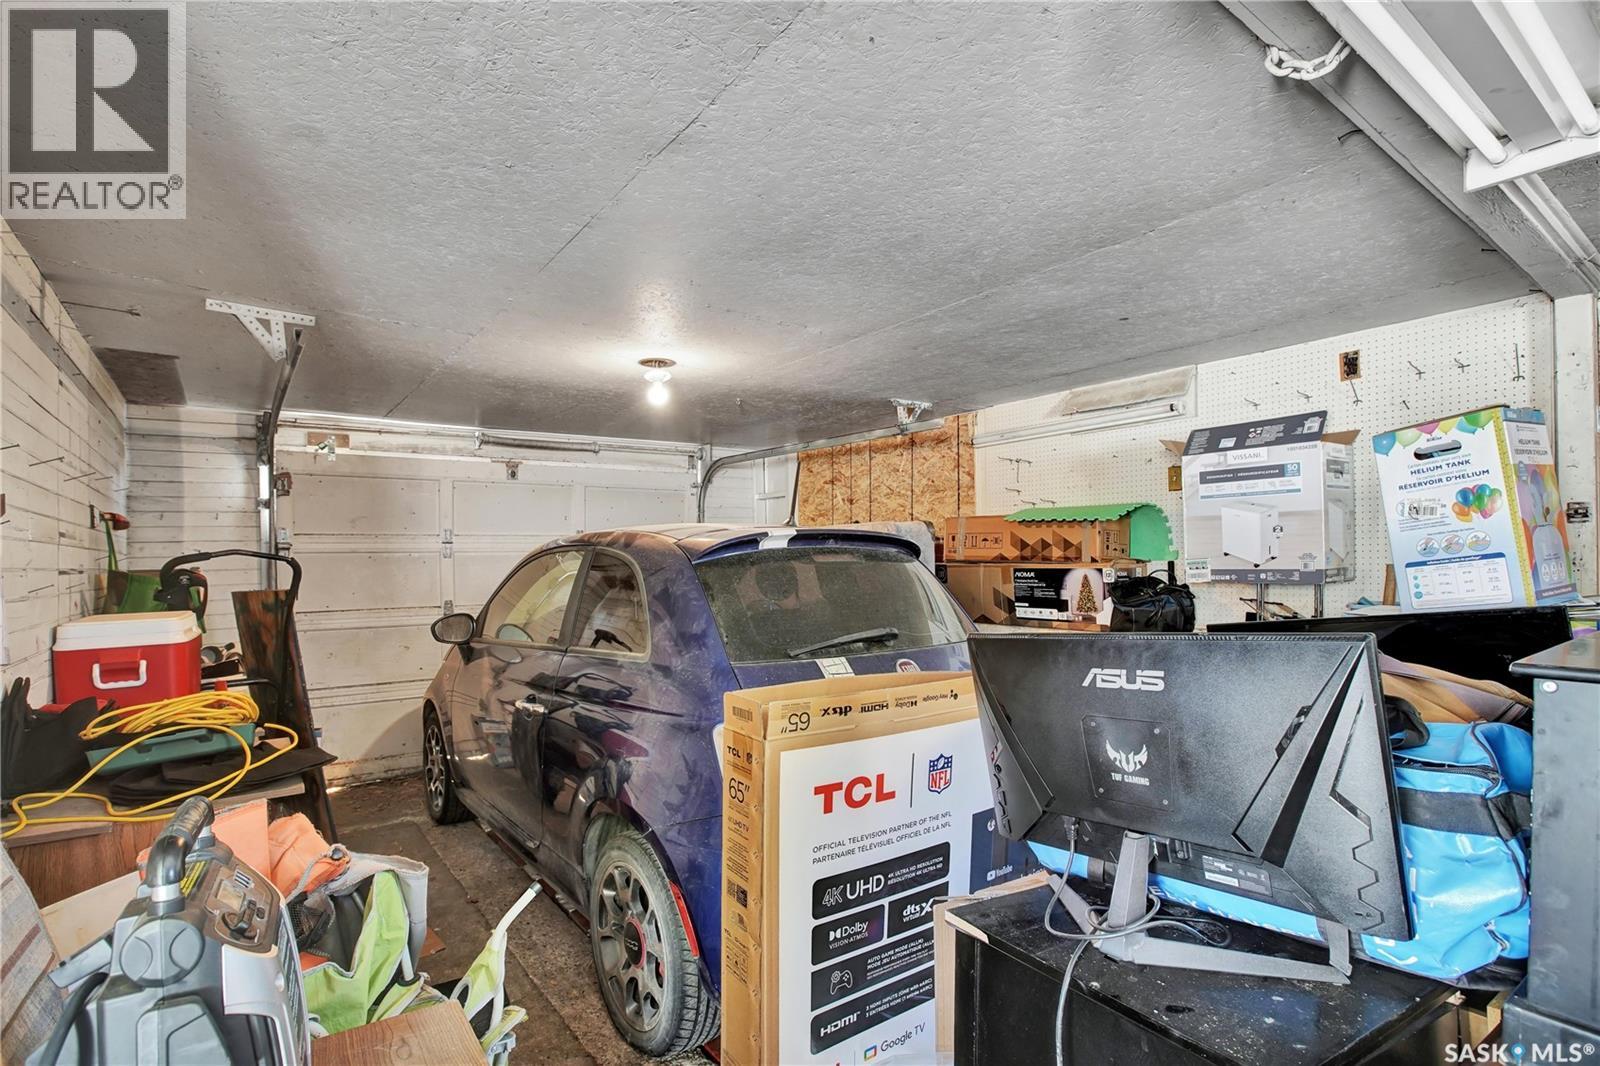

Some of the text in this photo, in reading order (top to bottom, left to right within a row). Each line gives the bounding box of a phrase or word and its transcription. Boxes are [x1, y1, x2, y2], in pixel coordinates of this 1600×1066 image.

[1410, 464, 1443, 476] HELIUM
[1445, 459, 1471, 469] TANK
[1081, 667, 1165, 692] ASUS
[727, 745, 741, 759] TCL
[929, 769, 950, 791] NFL
[1124, 774, 1150, 786] GAMING
[813, 773, 896, 815] TCL
[812, 840, 846, 854] OFFICIAL
[848, 829, 888, 844] TELEVISION
[889, 820, 917, 833] PARTNER
[918, 817, 928, 825] OF
[928, 813, 940, 822] THE
[812, 848, 855, 865] PARTENAIRE
[896, 830, 922, 843] OFFICIEL
[940, 821, 952, 829] NFL
[822, 874, 885, 907] 4K UHD
[842, 921, 869, 937] Dolby
[880, 1022, 926, 1052] Google TV
